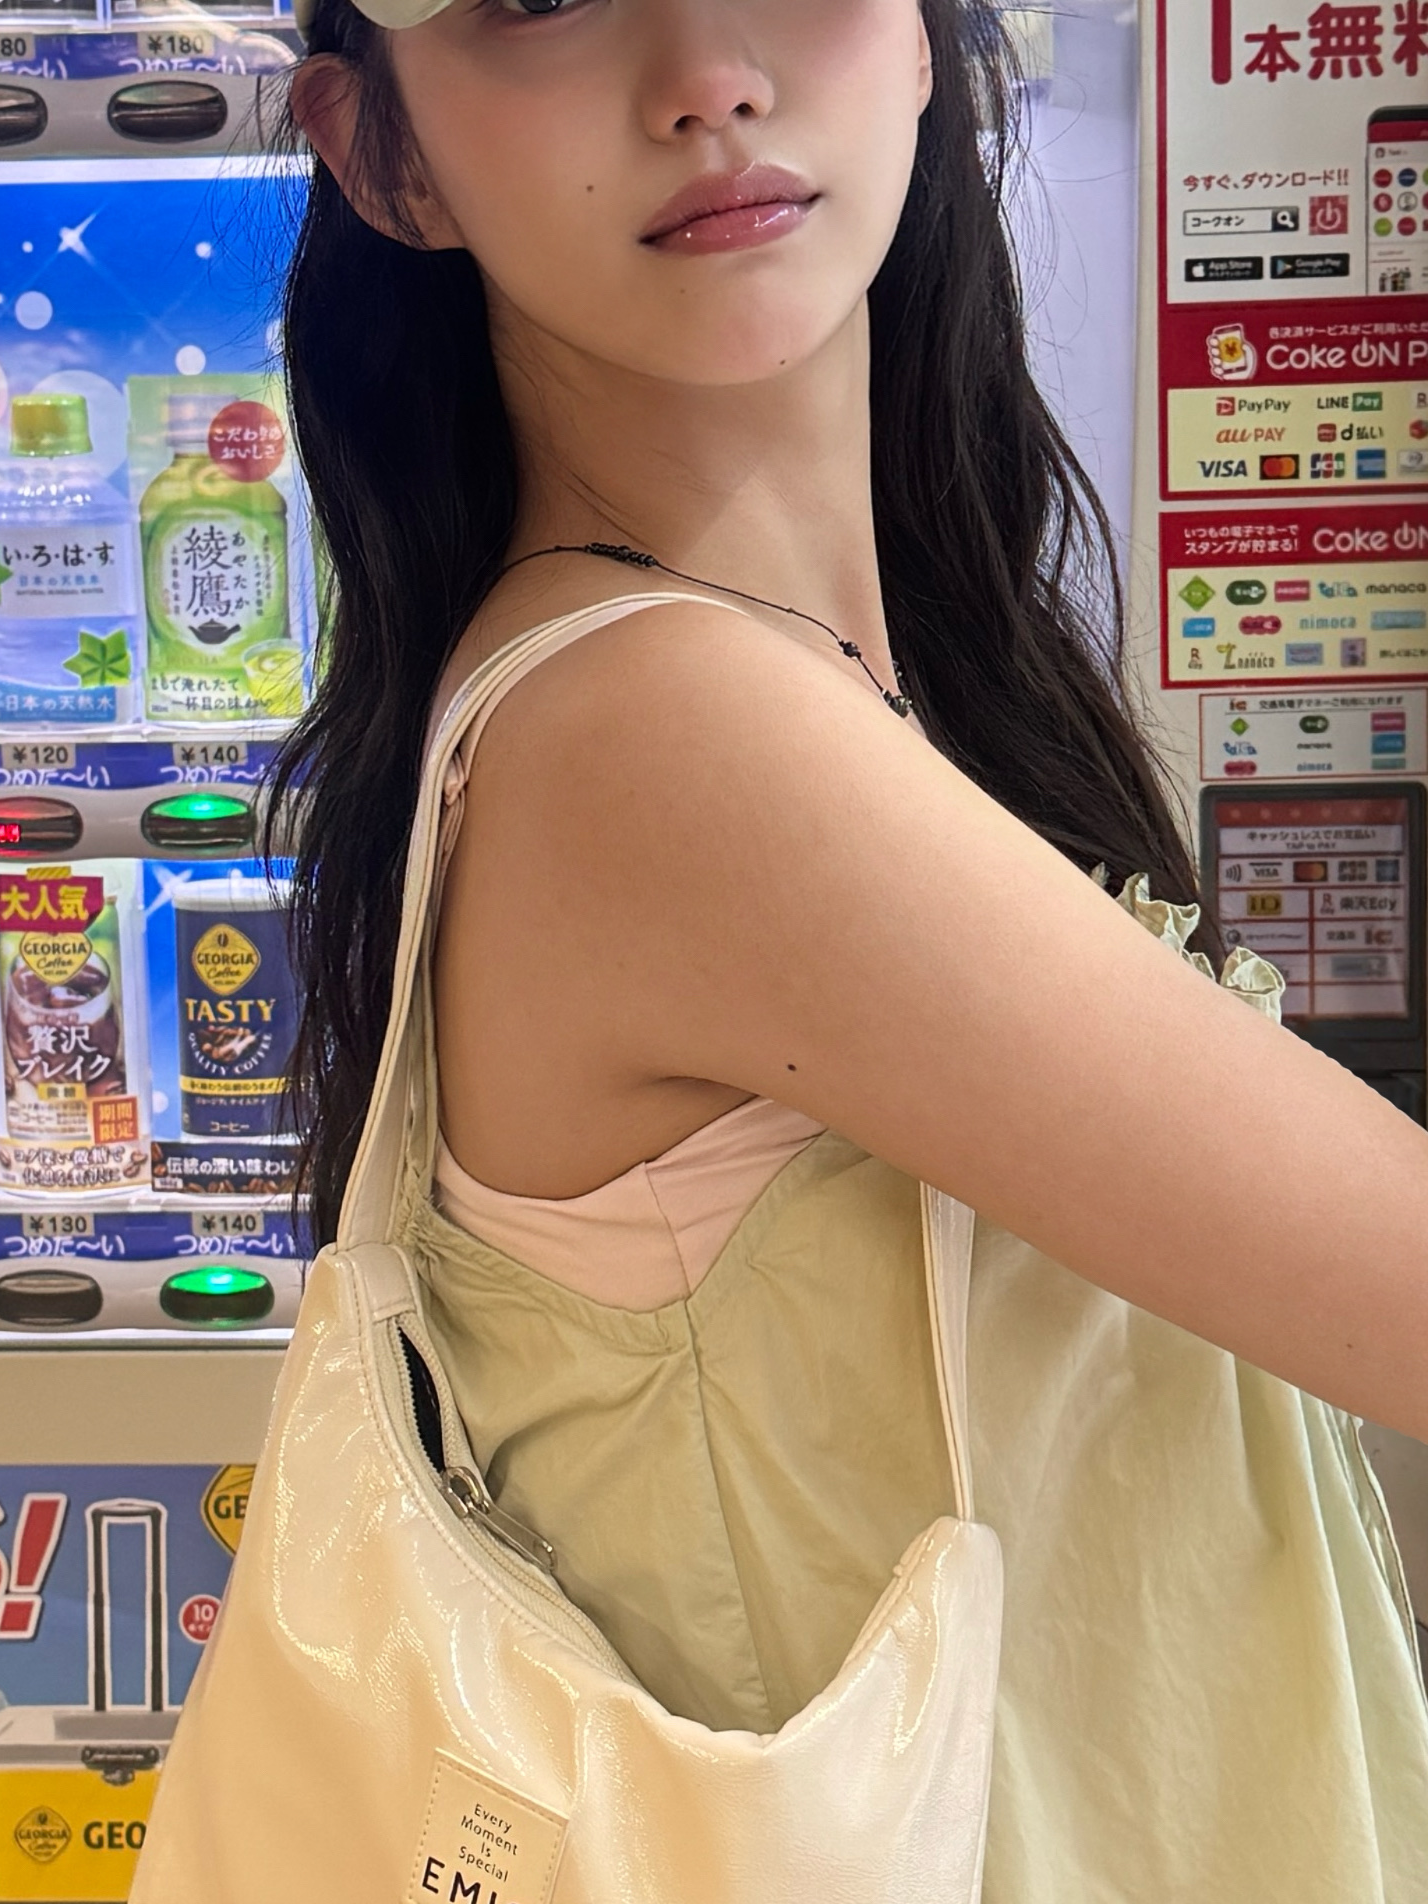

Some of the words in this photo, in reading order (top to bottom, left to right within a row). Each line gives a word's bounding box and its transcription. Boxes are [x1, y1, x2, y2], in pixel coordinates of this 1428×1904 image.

[1266, 343, 1346, 370] Coke
[1352, 337, 1400, 367] ON
[1237, 397, 1292, 413] PayPay
[1197, 459, 1249, 479] VISA
[183, 524, 235, 618] 綾鷹
[5, 694, 115, 711] 日本の天然水
[181, 745, 239, 764] ¥140
[23, 940, 89, 956] GEORGIA
[197, 952, 256, 966] GEORGIA
[185, 999, 276, 1023] TASTY
[27, 1025, 96, 1055] 贅沢
[18, 1055, 113, 1081] ブレイク
[200, 1215, 257, 1232] ¥140
[475, 1803, 512, 1834] Every
[461, 1815, 518, 1856] Moment
[480, 1843, 491, 1858] Is
[458, 1846, 508, 1883] Special
